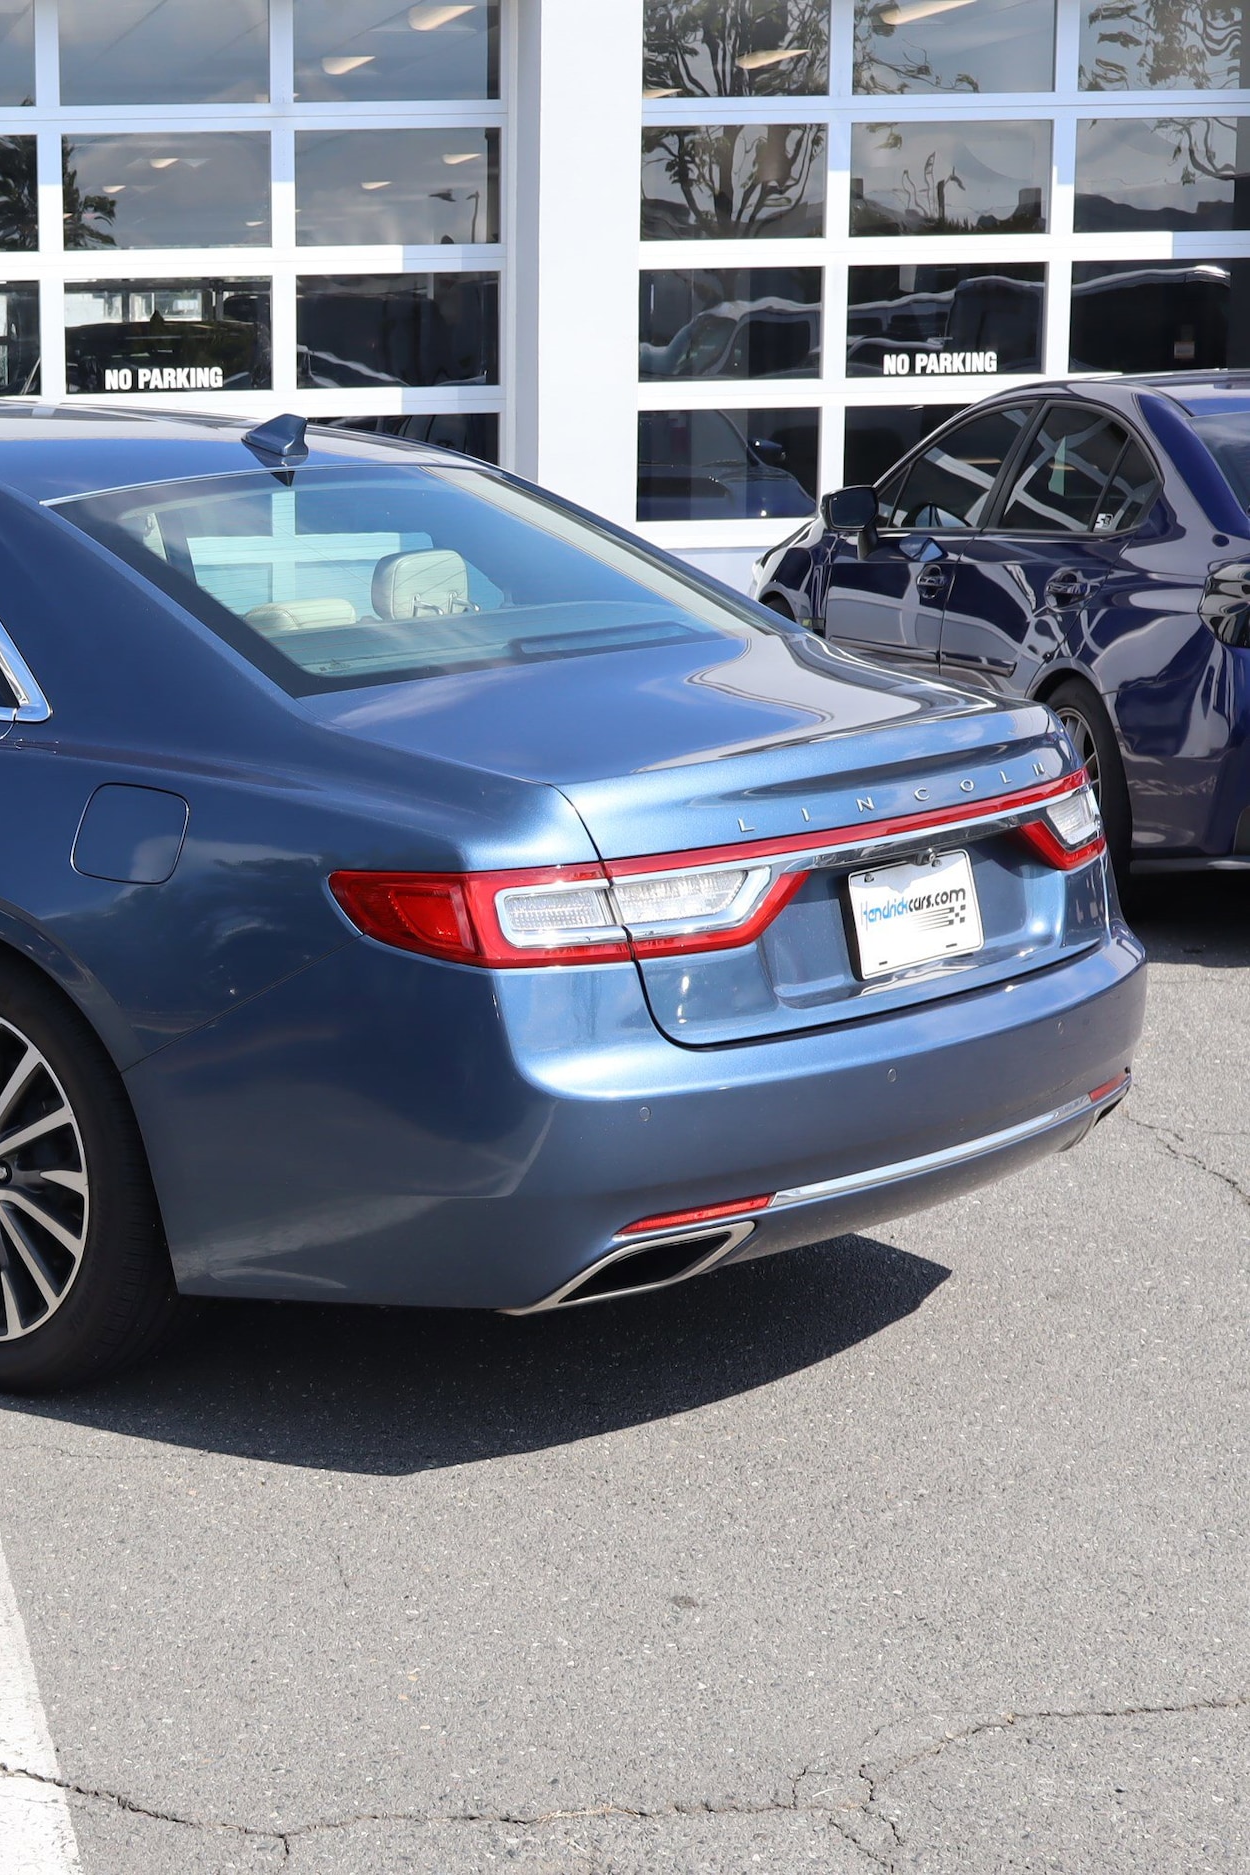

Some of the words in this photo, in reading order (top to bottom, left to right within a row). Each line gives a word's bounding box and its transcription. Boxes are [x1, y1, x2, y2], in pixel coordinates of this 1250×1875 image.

[883, 353, 910, 375] NO
[915, 351, 997, 374] PARKING
[105, 368, 132, 390] NO
[138, 366, 223, 390] PARKING
[738, 762, 1045, 832] LINCOLN
